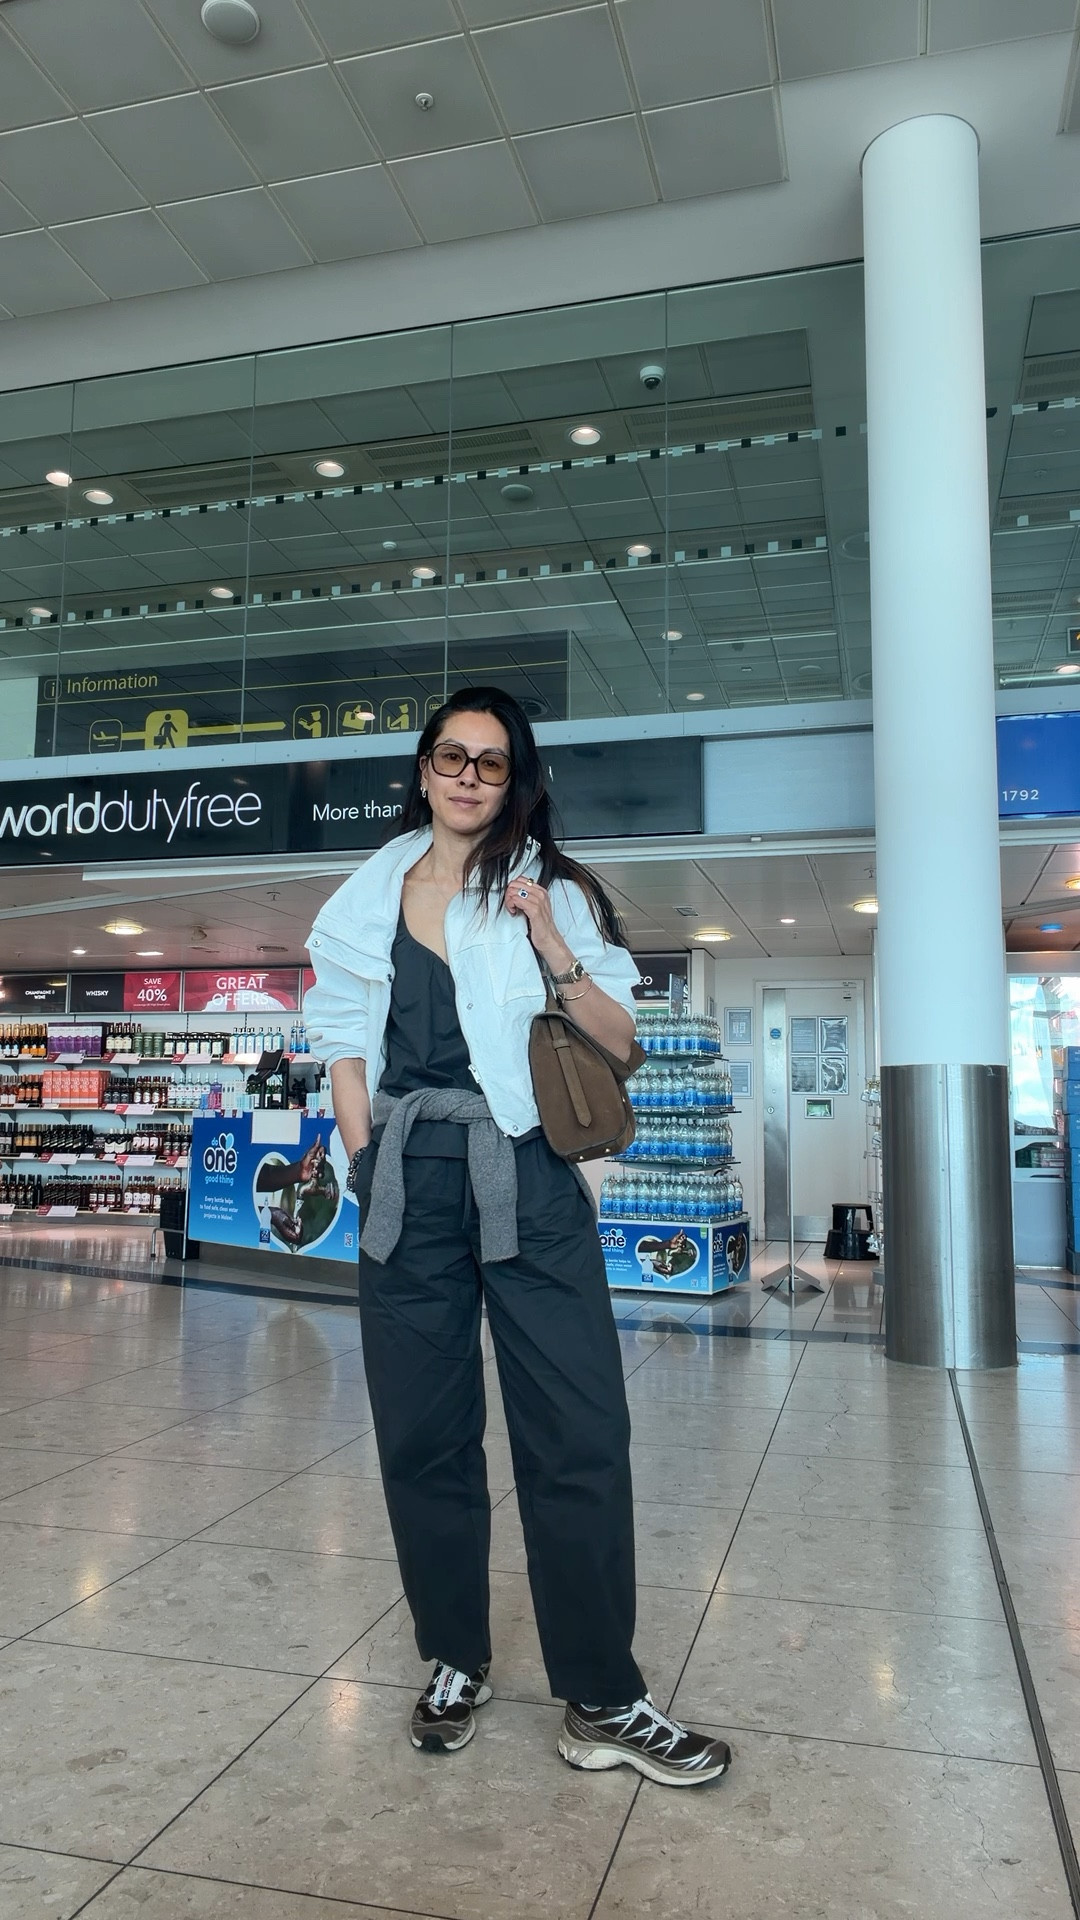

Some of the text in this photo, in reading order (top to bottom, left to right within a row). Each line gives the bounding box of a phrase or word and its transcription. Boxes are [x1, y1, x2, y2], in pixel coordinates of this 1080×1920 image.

[67, 674, 158, 694] Information
[1002, 789, 1039, 802] 1792
[313, 800, 402, 821] More than
[143, 977, 162, 985] SAVE
[216, 976, 266, 990] GREAT
[137, 988, 167, 1002] 40%
[212, 992, 269, 1005] OFFERS
[211, 1137, 218, 1146] do
[204, 1147, 237, 1174] one
[205, 1174, 234, 1186] good thing
[599, 1234, 626, 1249] one
